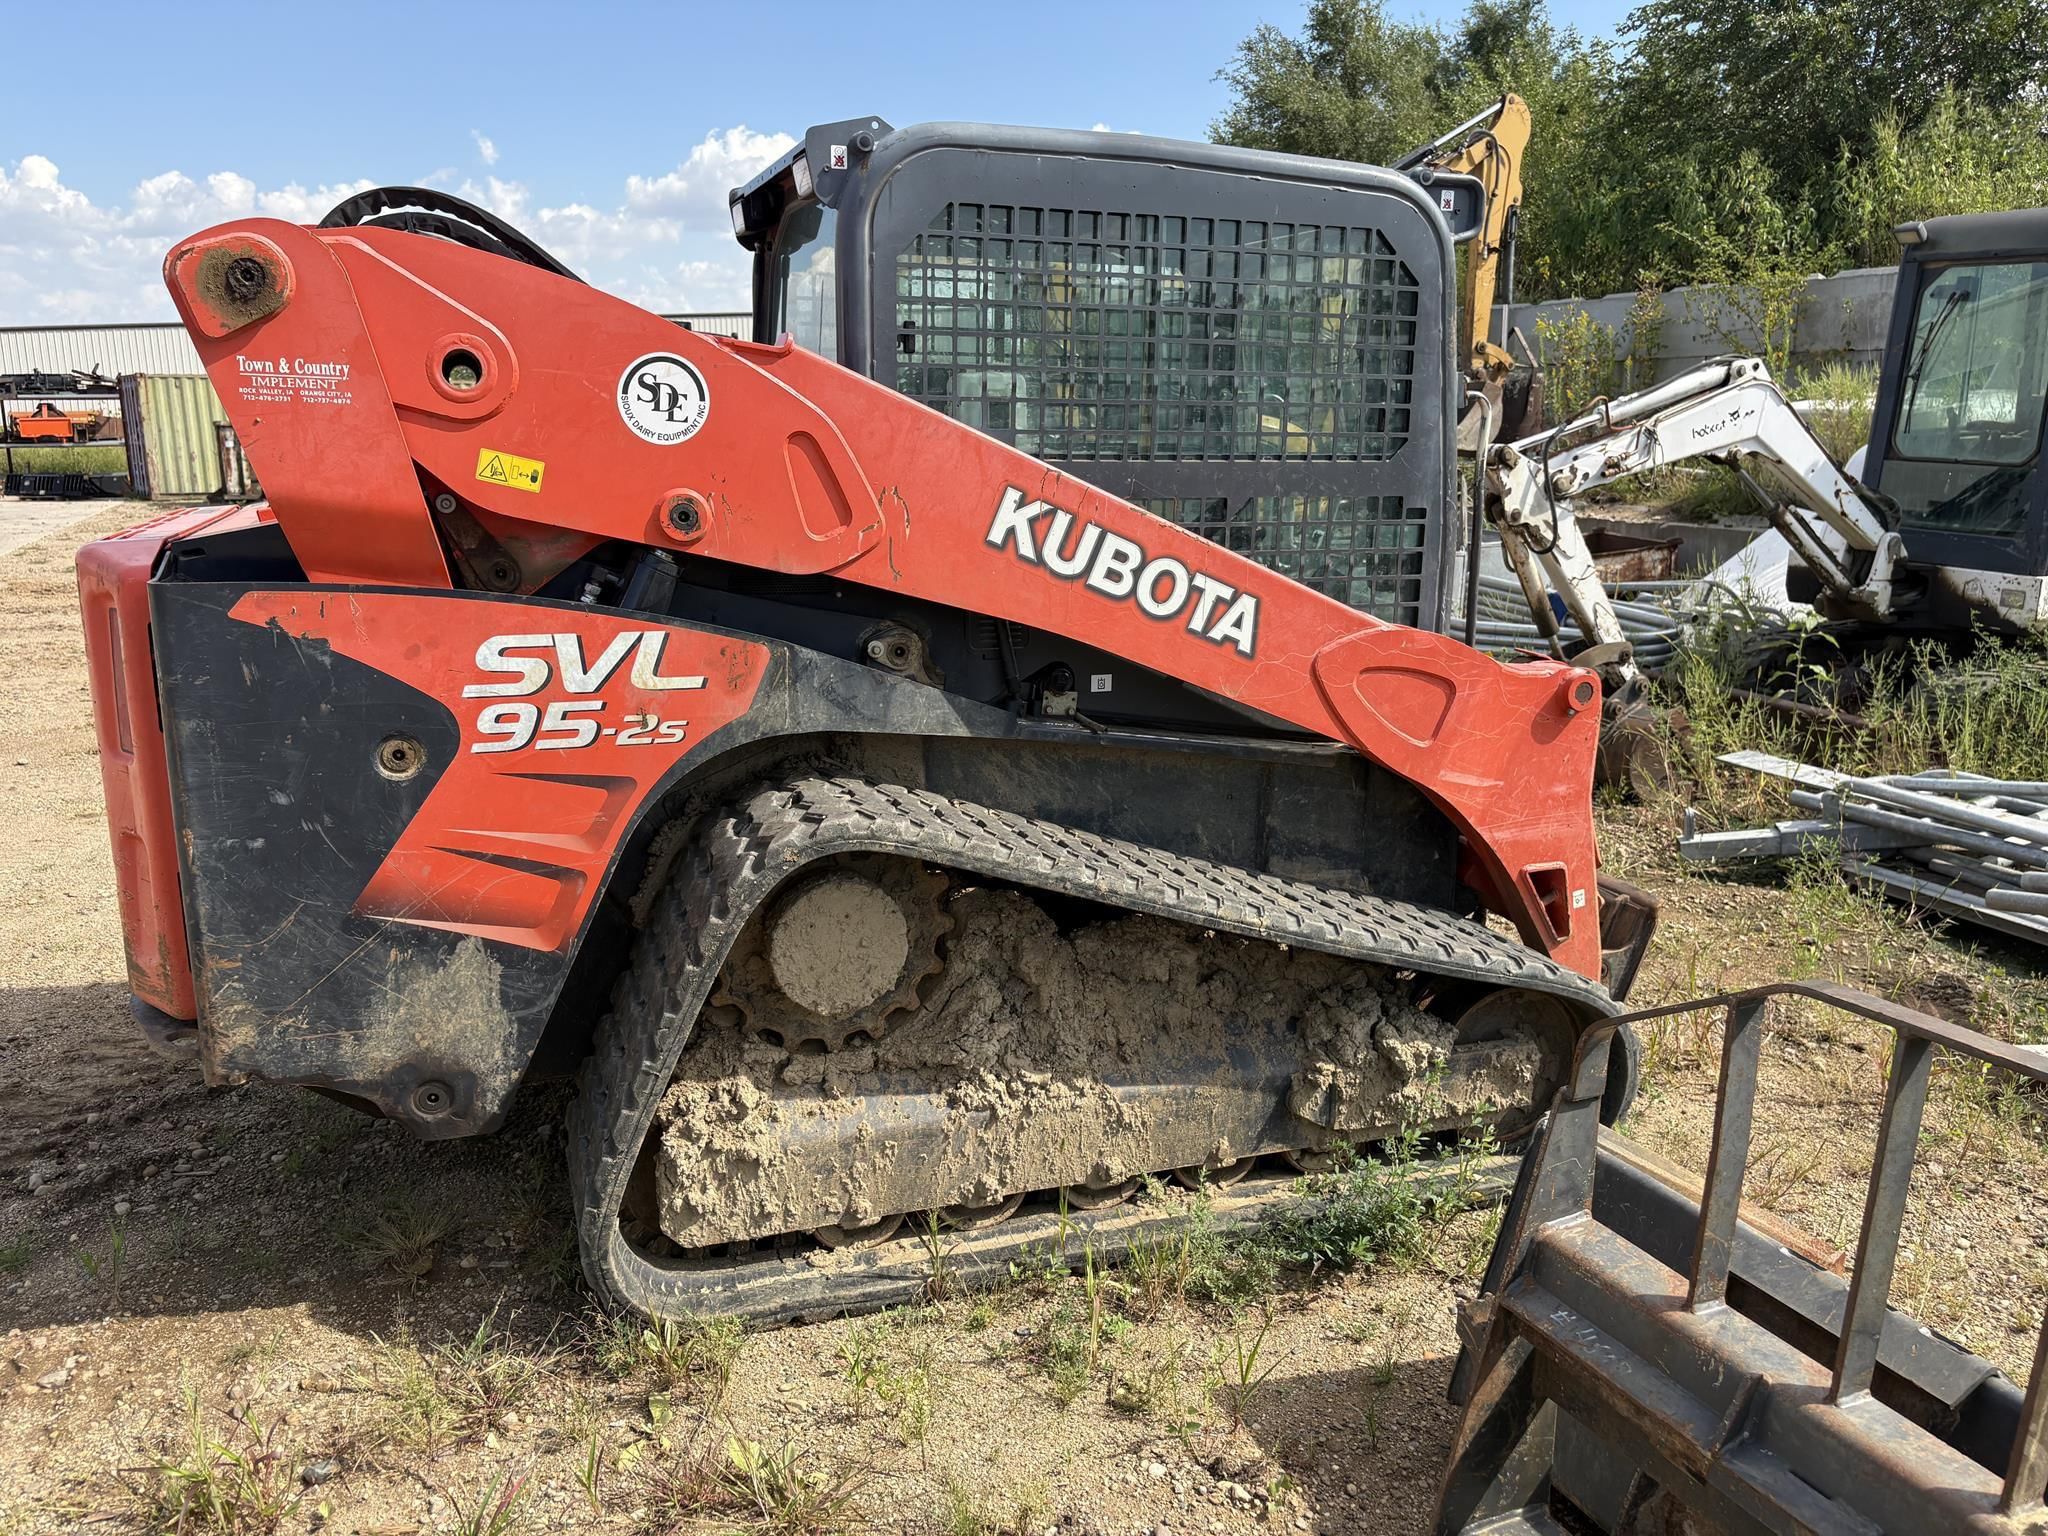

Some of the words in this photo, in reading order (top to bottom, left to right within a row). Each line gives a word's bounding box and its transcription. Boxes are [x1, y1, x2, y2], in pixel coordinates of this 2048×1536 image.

[236, 356, 274, 373] Town
[278, 357, 291, 374] &
[295, 358, 350, 380] Country
[252, 376, 338, 390] IMPLEMENT
[621, 395, 636, 422] SIOUX
[632, 419, 657, 439] DAIRY
[657, 418, 702, 442] EQUIPMENT
[636, 373, 688, 423] SDE
[985, 485, 1259, 656] KUBOTA
[460, 630, 709, 698] SVL
